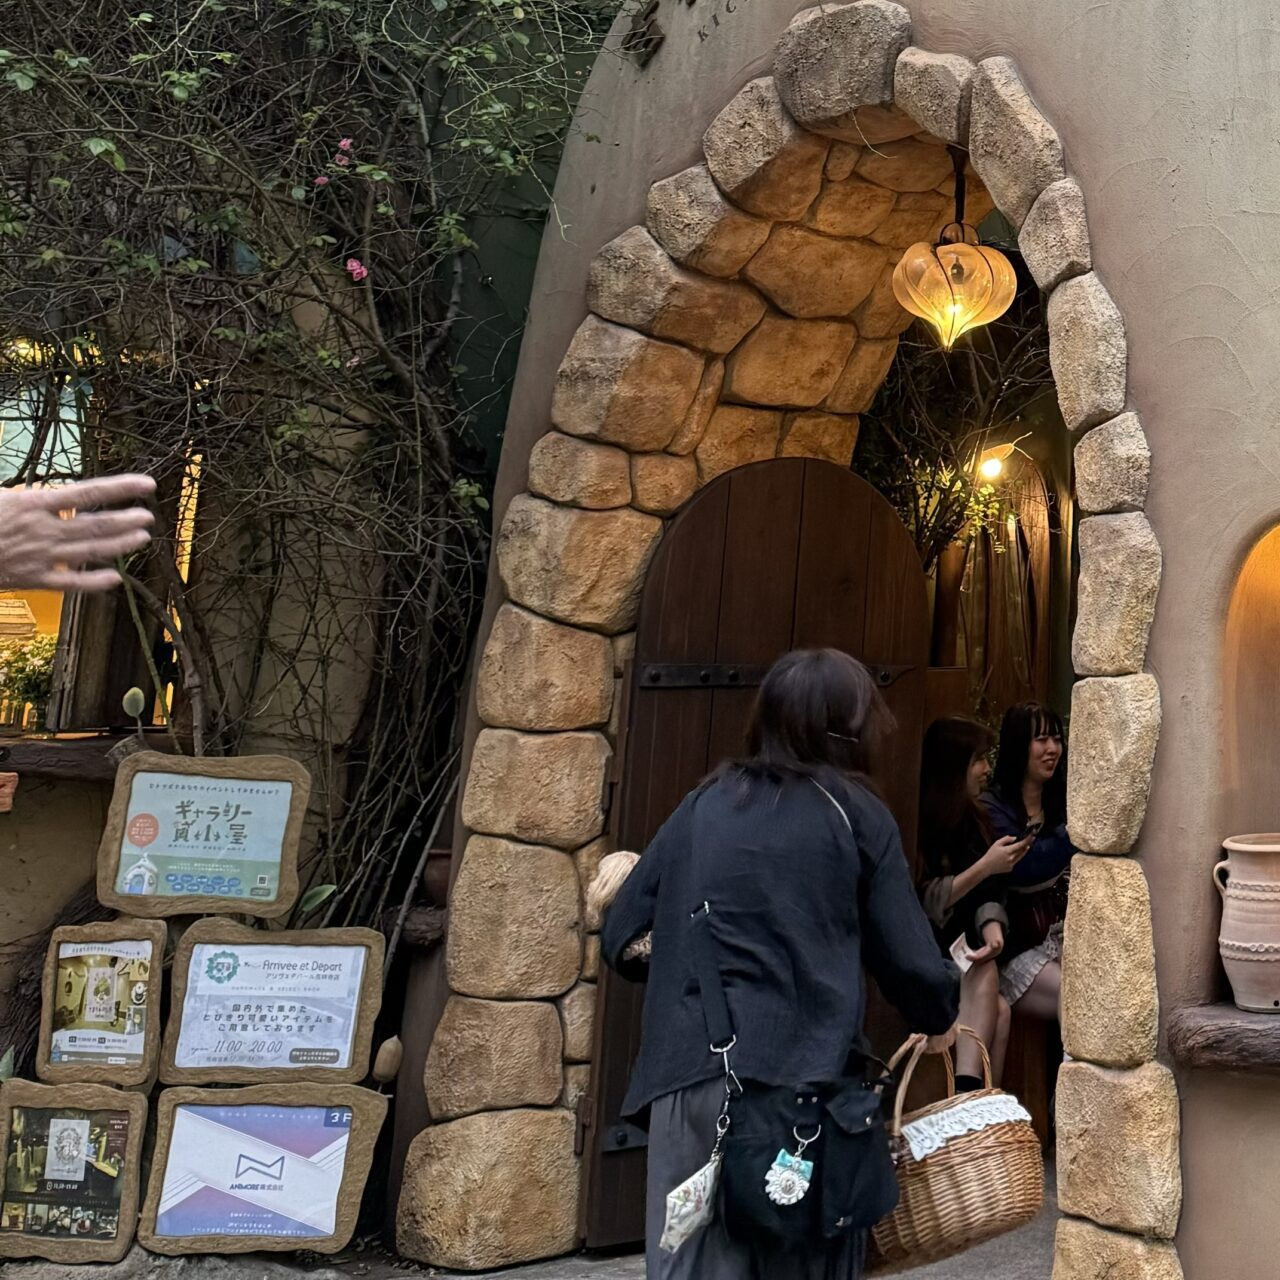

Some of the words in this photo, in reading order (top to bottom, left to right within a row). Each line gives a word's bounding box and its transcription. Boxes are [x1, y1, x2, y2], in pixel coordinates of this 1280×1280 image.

[175, 799, 253, 822] ギャラリー
